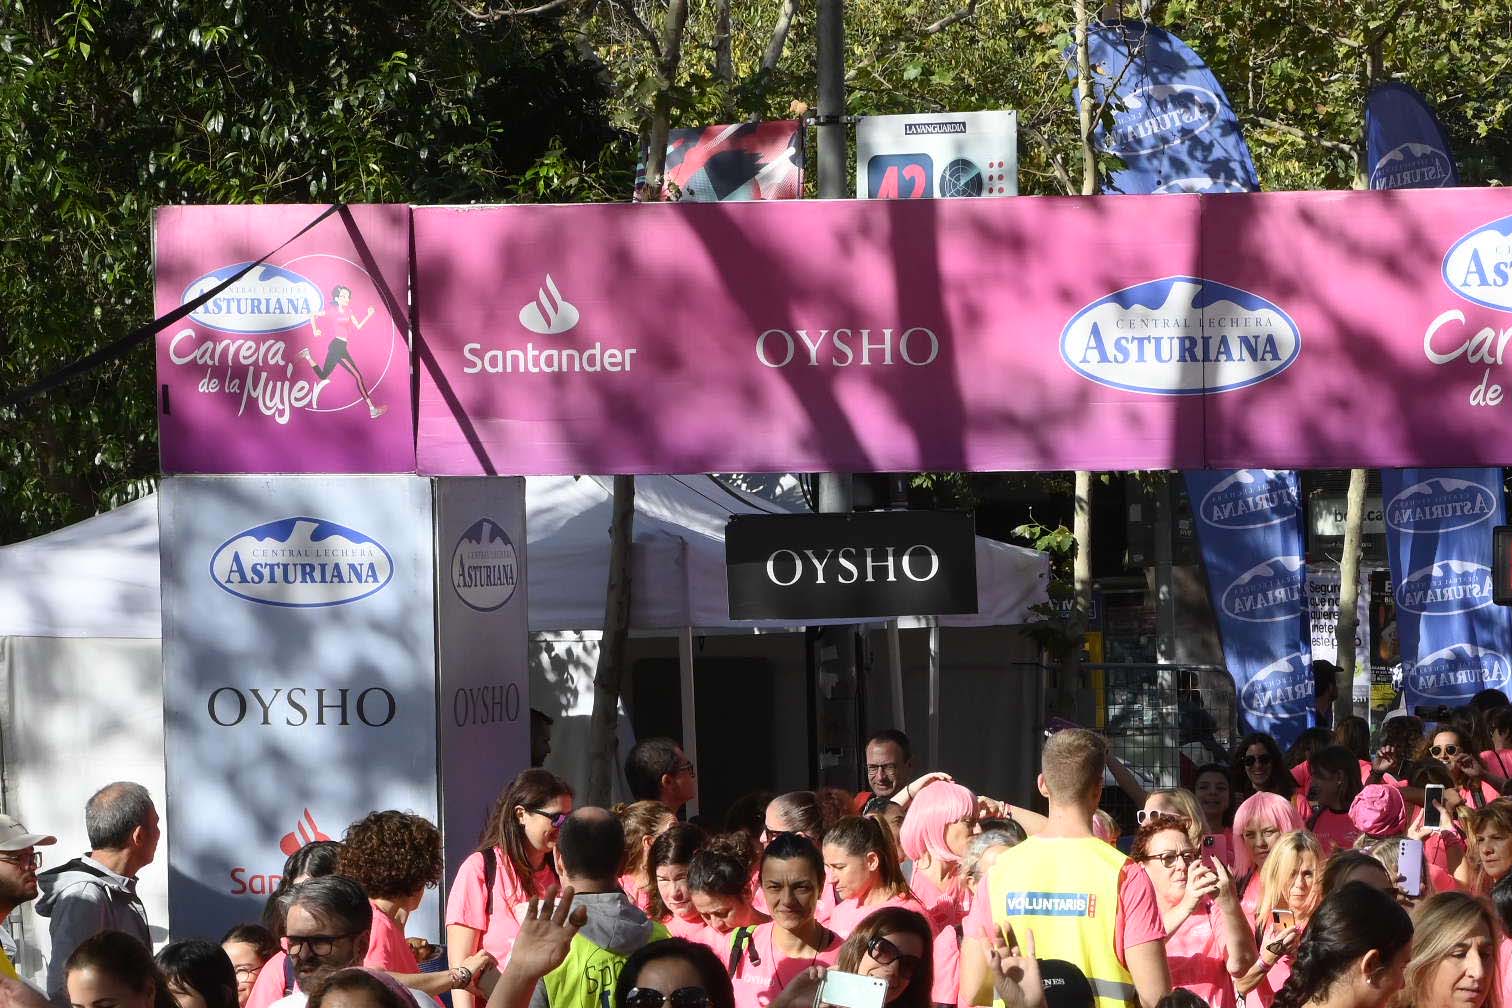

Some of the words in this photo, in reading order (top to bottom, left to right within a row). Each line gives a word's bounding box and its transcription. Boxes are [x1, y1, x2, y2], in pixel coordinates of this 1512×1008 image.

[193, 289, 312, 314] ASTURIANA
[1116, 317, 1191, 329] CENTRAL
[1199, 316, 1273, 329] LECHERA
[169, 329, 285, 365] Carrera
[463, 342, 637, 373] Santander
[755, 327, 939, 368] OYSHO
[1079, 321, 1282, 364] ASTURIANA
[198, 369, 219, 392] de
[225, 367, 240, 392] la
[238, 363, 330, 424] Mujer
[1469, 368, 1503, 407] de
[225, 551, 382, 584] ASTURIANA
[457, 553, 515, 589] ASTURIANA
[766, 544, 939, 586] OYSHO
[207, 687, 396, 727] OYSHO
[453, 682, 520, 727] OYSHO
[1006, 897, 1087, 912] VOLUNTARIS
